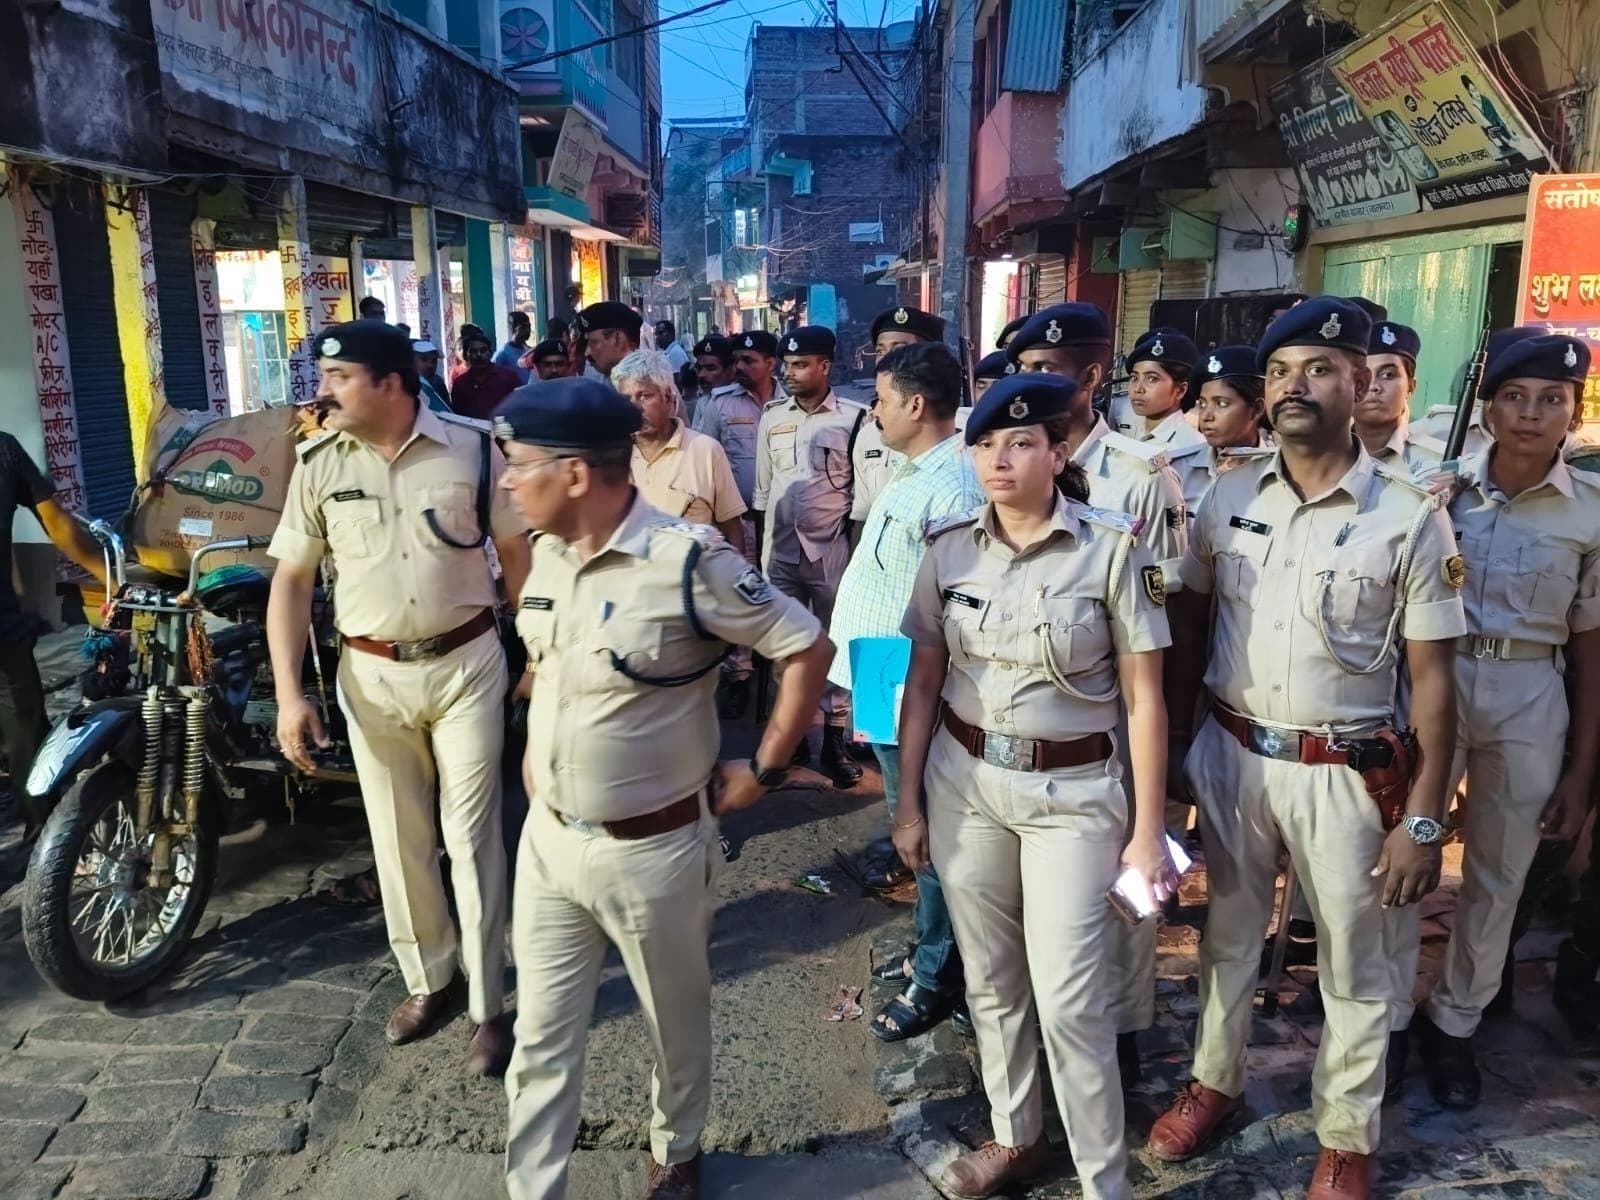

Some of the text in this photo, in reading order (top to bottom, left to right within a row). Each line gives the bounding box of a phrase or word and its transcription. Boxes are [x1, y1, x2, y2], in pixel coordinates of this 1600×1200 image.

[1531, 274, 1571, 314] शुभ
[183, 506, 245, 521] Since 1986
